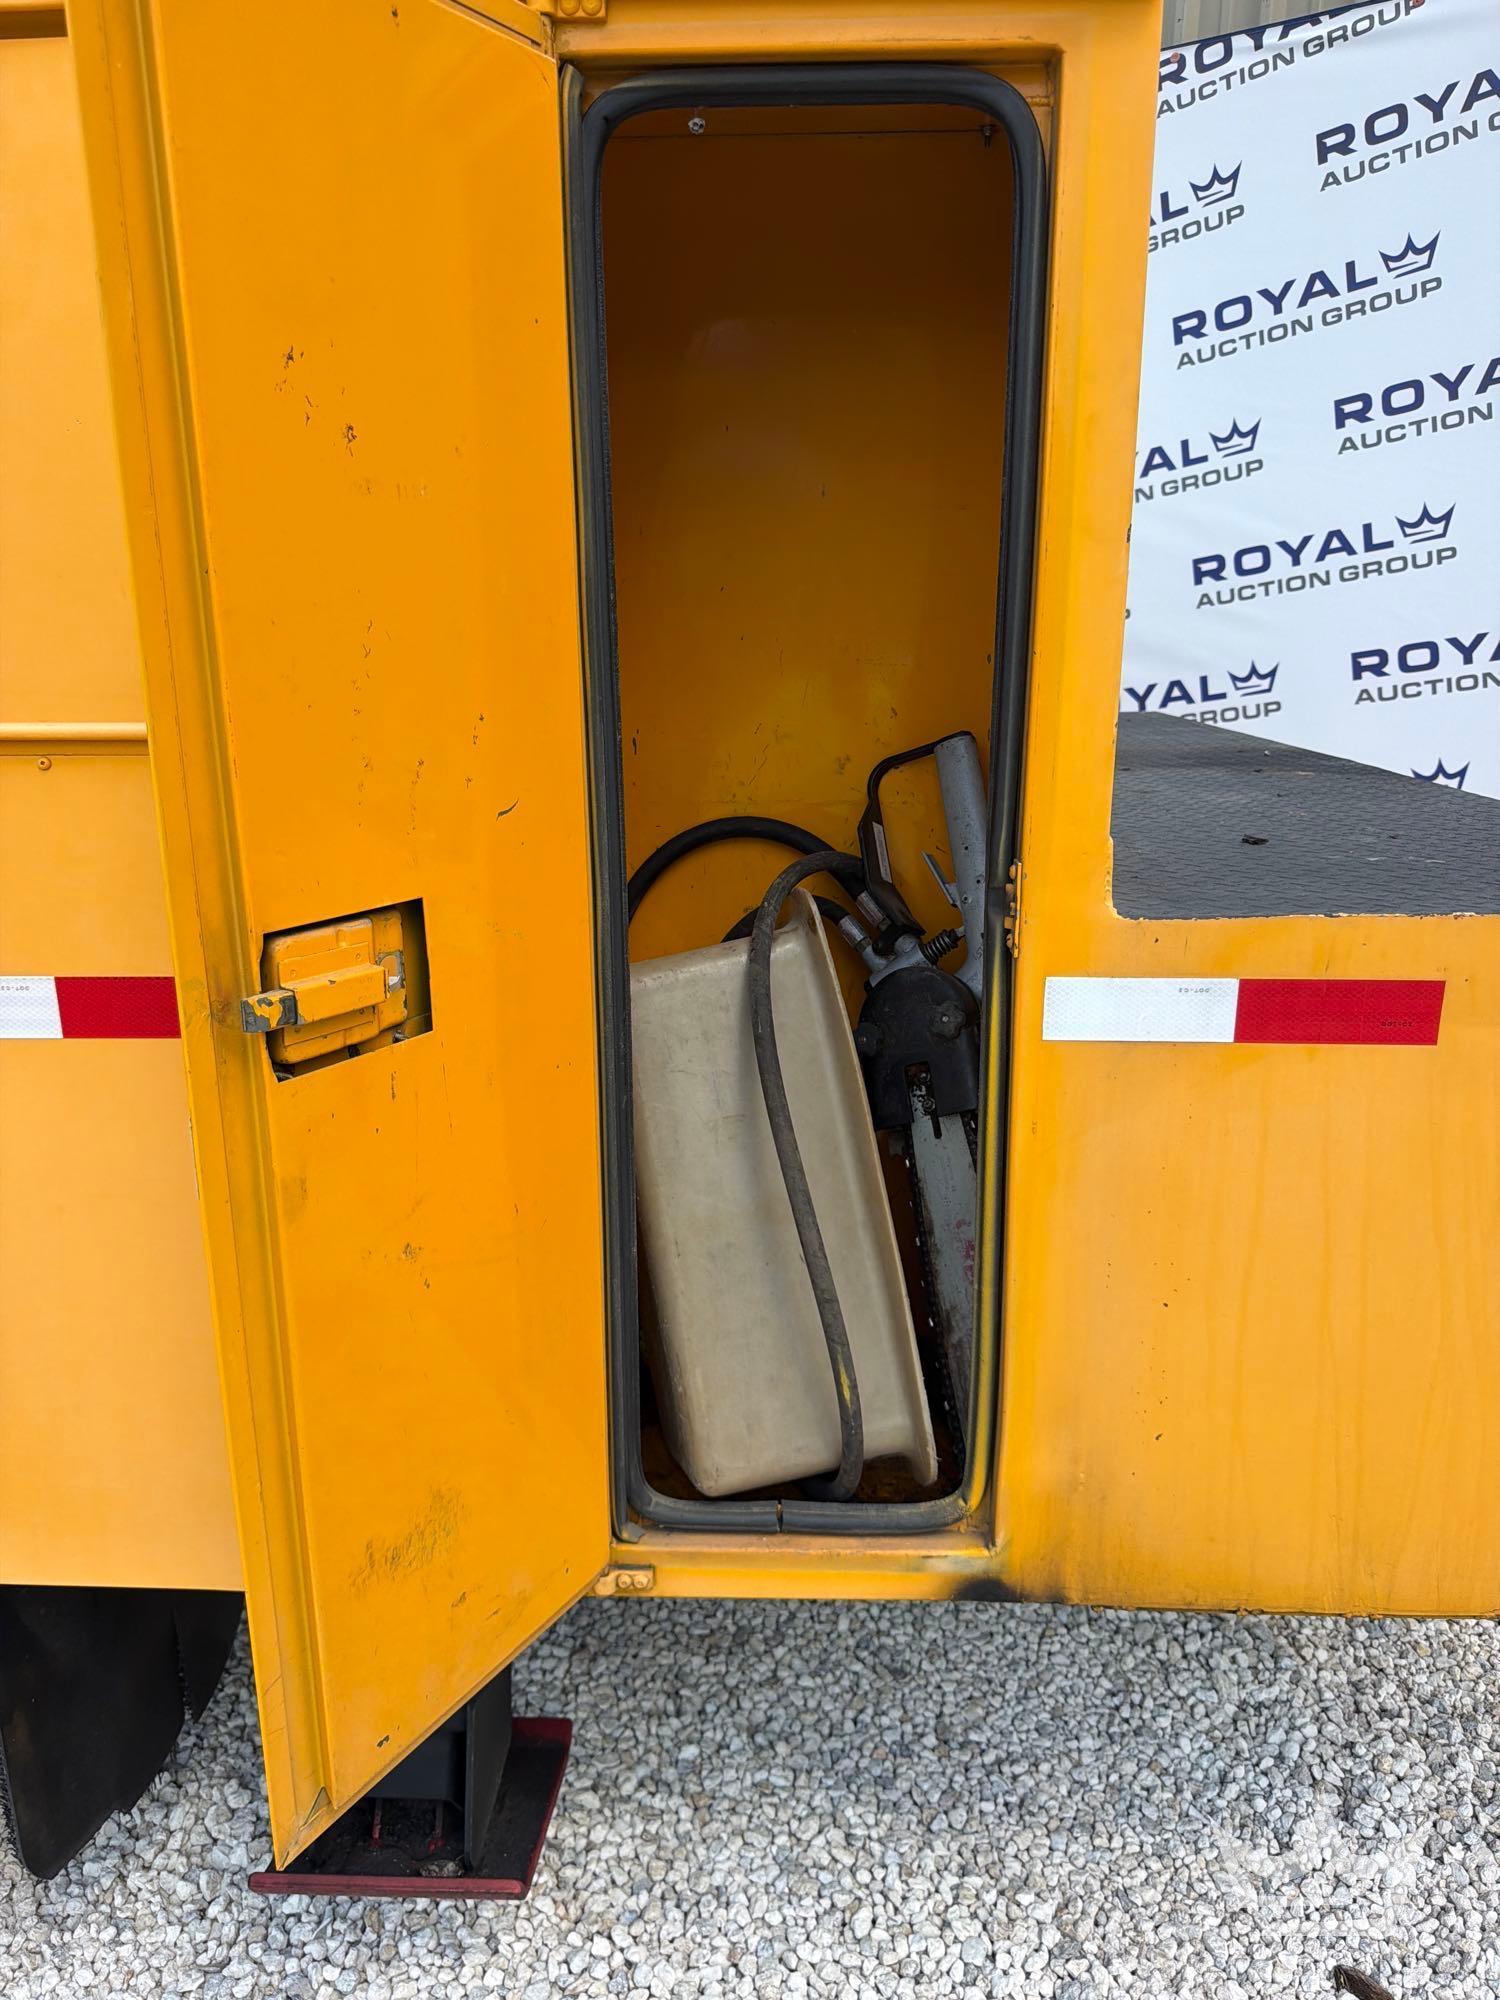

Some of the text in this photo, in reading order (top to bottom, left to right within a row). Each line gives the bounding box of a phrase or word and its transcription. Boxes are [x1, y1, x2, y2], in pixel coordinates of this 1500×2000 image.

[1157, 47, 1295, 119] AUCTION
[1320, 120, 1479, 192] AUCTION
[1172, 260, 1378, 346] ROYAL
[1177, 276, 1442, 370] AUCTION GROUP
[1338, 402, 1493, 455] AUCTION
[1161, 459, 1264, 497] GROUP
[1192, 522, 1394, 586] ROYAL
[1196, 546, 1457, 609] AUCTION GROUP
[1351, 632, 1500, 681] ROY
[1354, 672, 1500, 705] AUCTION
